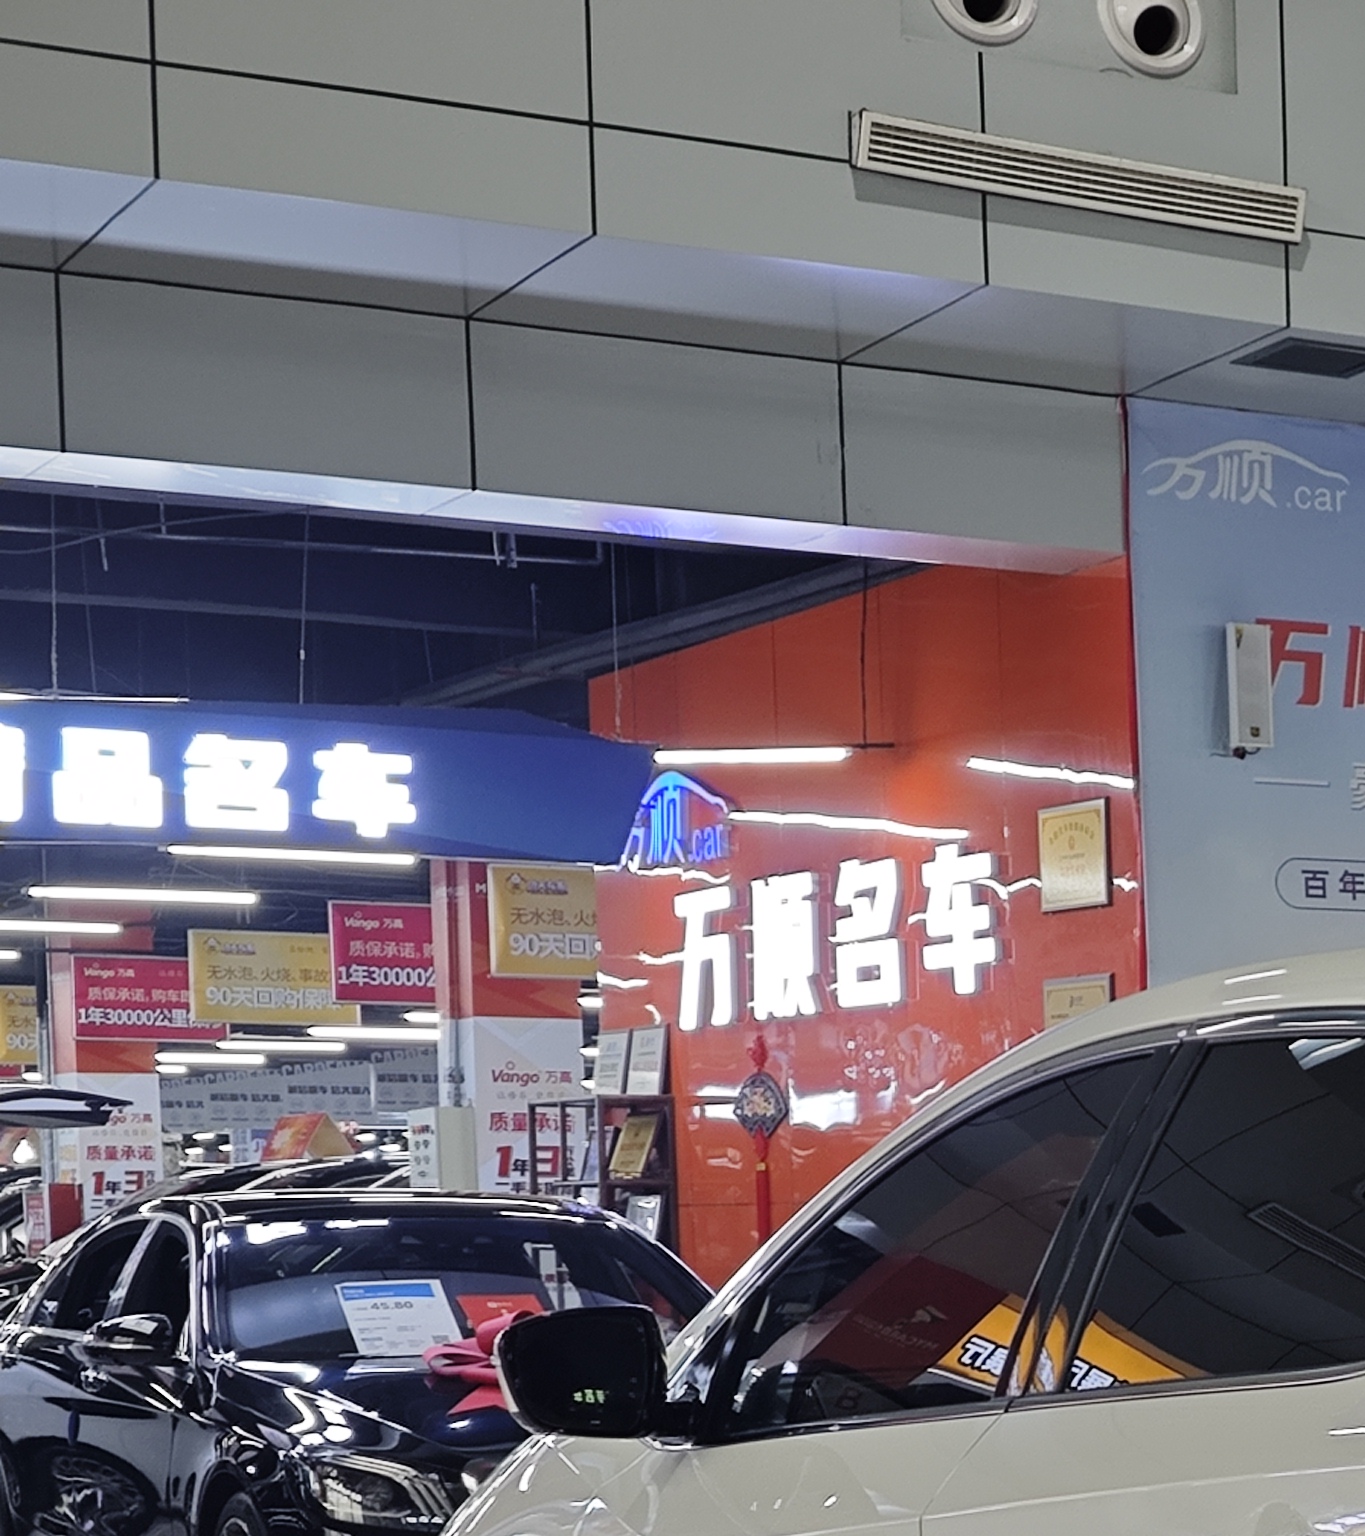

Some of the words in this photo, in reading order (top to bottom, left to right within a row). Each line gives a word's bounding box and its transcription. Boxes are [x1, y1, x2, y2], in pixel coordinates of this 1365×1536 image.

[0, 720, 417, 839] 品名车
[673, 843, 998, 1032] 万顺名车
[490, 1062, 541, 1087] Vango
